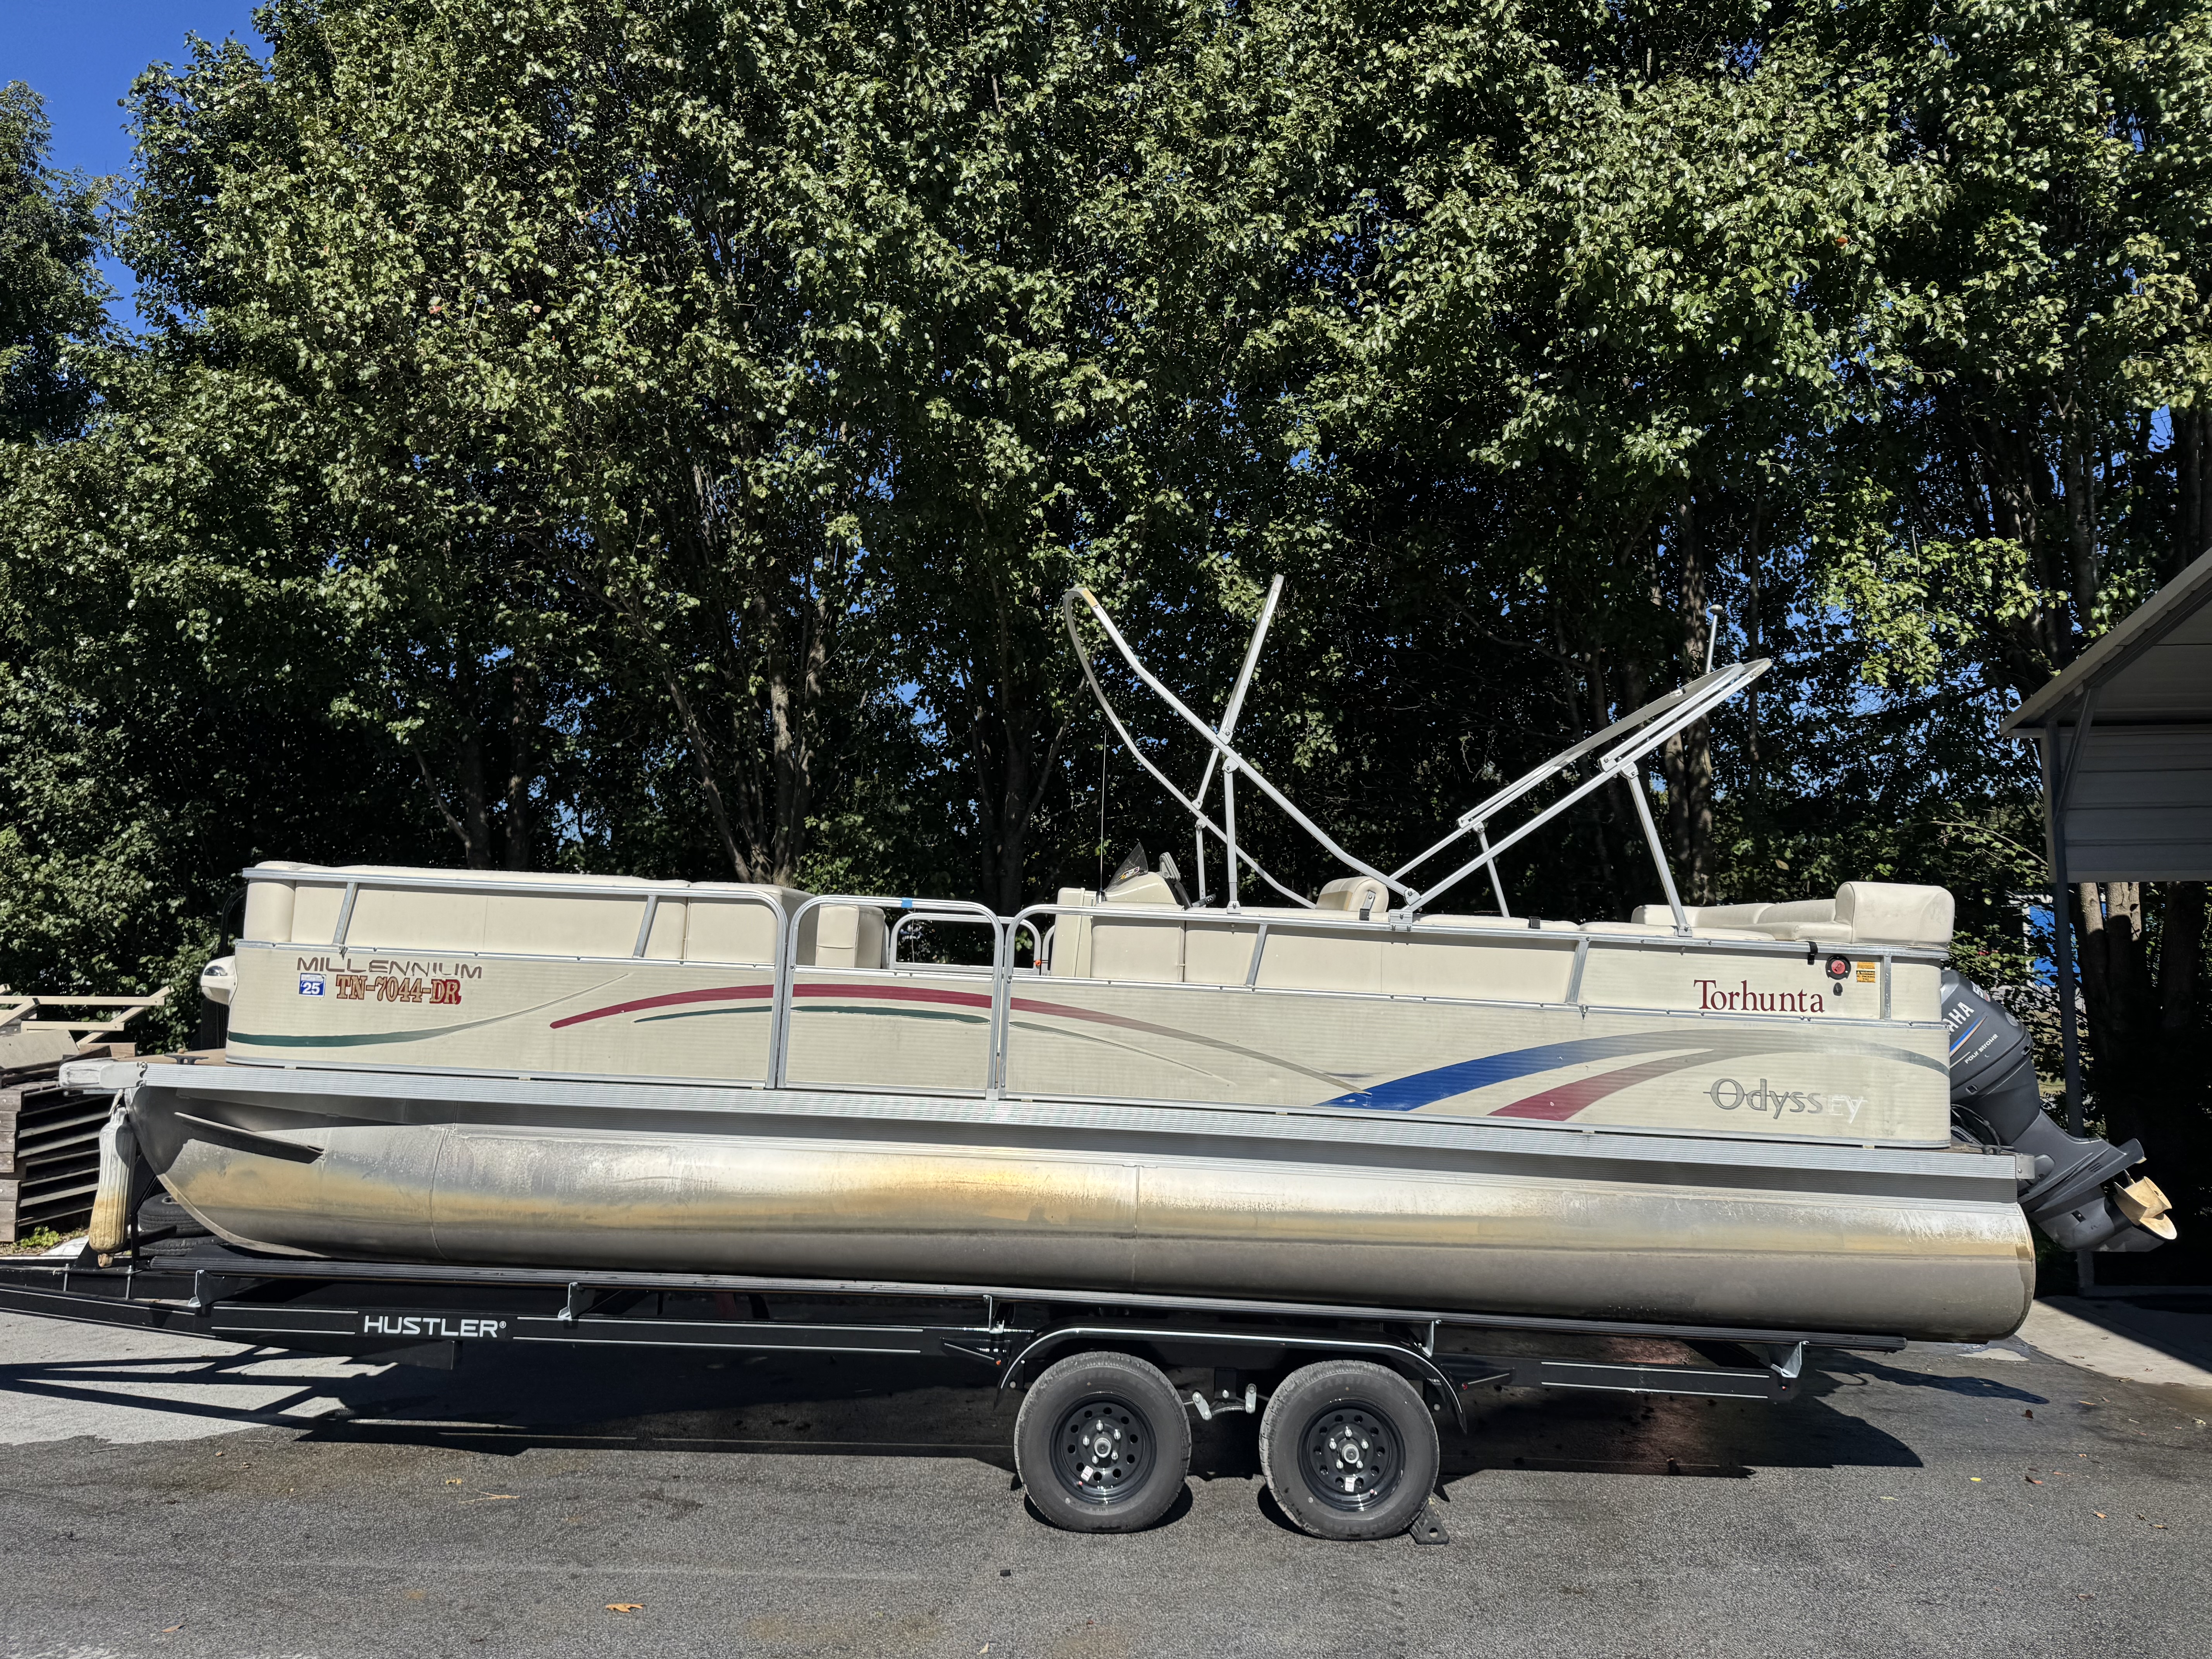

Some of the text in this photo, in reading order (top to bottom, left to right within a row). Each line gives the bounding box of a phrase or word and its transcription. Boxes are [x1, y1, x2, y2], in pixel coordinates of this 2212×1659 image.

[297, 957, 482, 979] MILLENNIUM
[302, 982, 320, 994] 25
[336, 974, 462, 1005] TN-7044-DR
[1693, 980, 1825, 1013] Torhunta
[1942, 1001, 1975, 1032] AHA
